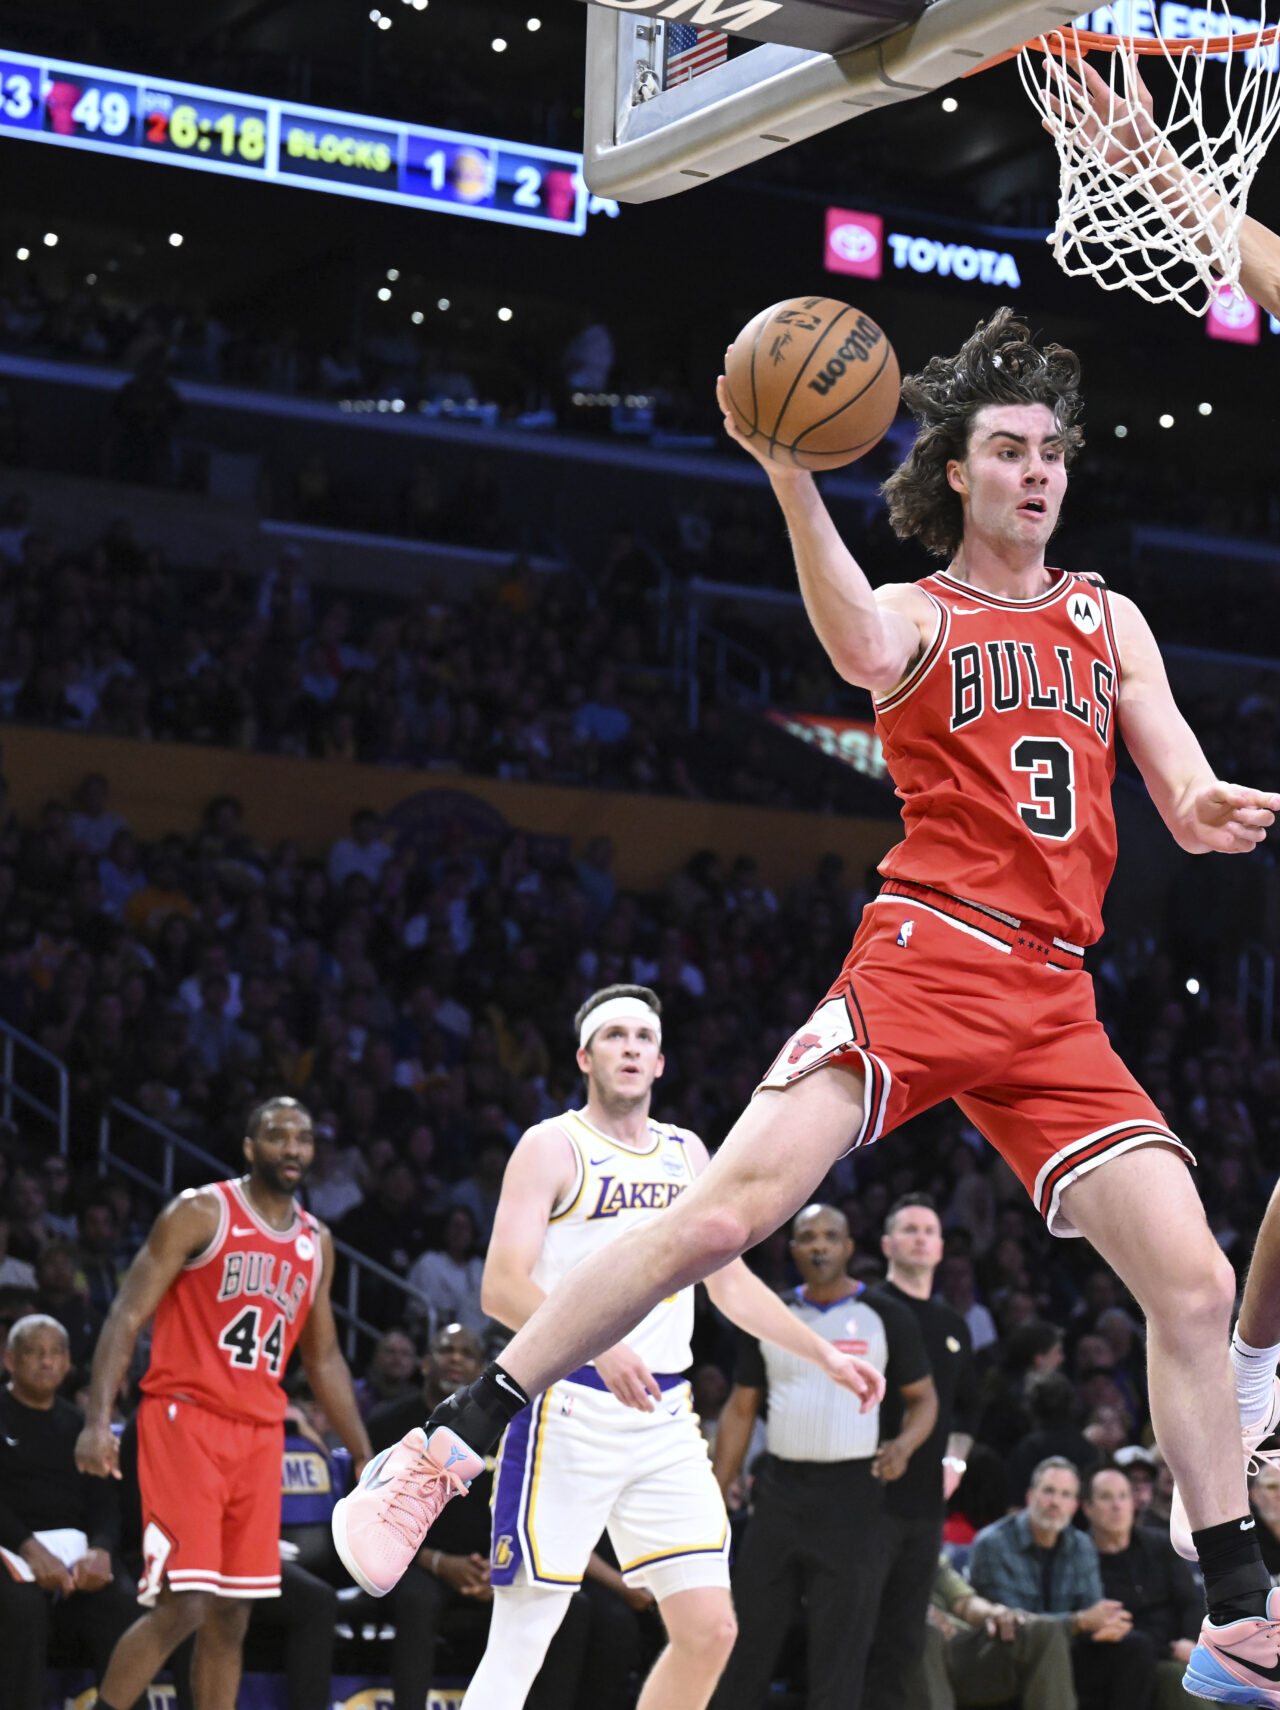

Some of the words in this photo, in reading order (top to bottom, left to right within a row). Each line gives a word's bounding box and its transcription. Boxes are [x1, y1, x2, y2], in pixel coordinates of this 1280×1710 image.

[0, 73, 33, 119] 3
[71, 87, 131, 137] 49
[146, 111, 168, 144] 2
[169, 104, 266, 162] 6:18
[287, 127, 392, 173] BLOCKS
[424, 150, 447, 192] 1
[512, 165, 542, 209] 2
[887, 232, 1022, 289] TOYOTA
[808, 314, 883, 396] Wilson
[949, 639, 1115, 747] BULLS
[1010, 735, 1076, 842] 3
[586, 1175, 688, 1221] LAKER
[216, 1250, 308, 1325] BULLS
[218, 1304, 286, 1378] 44
